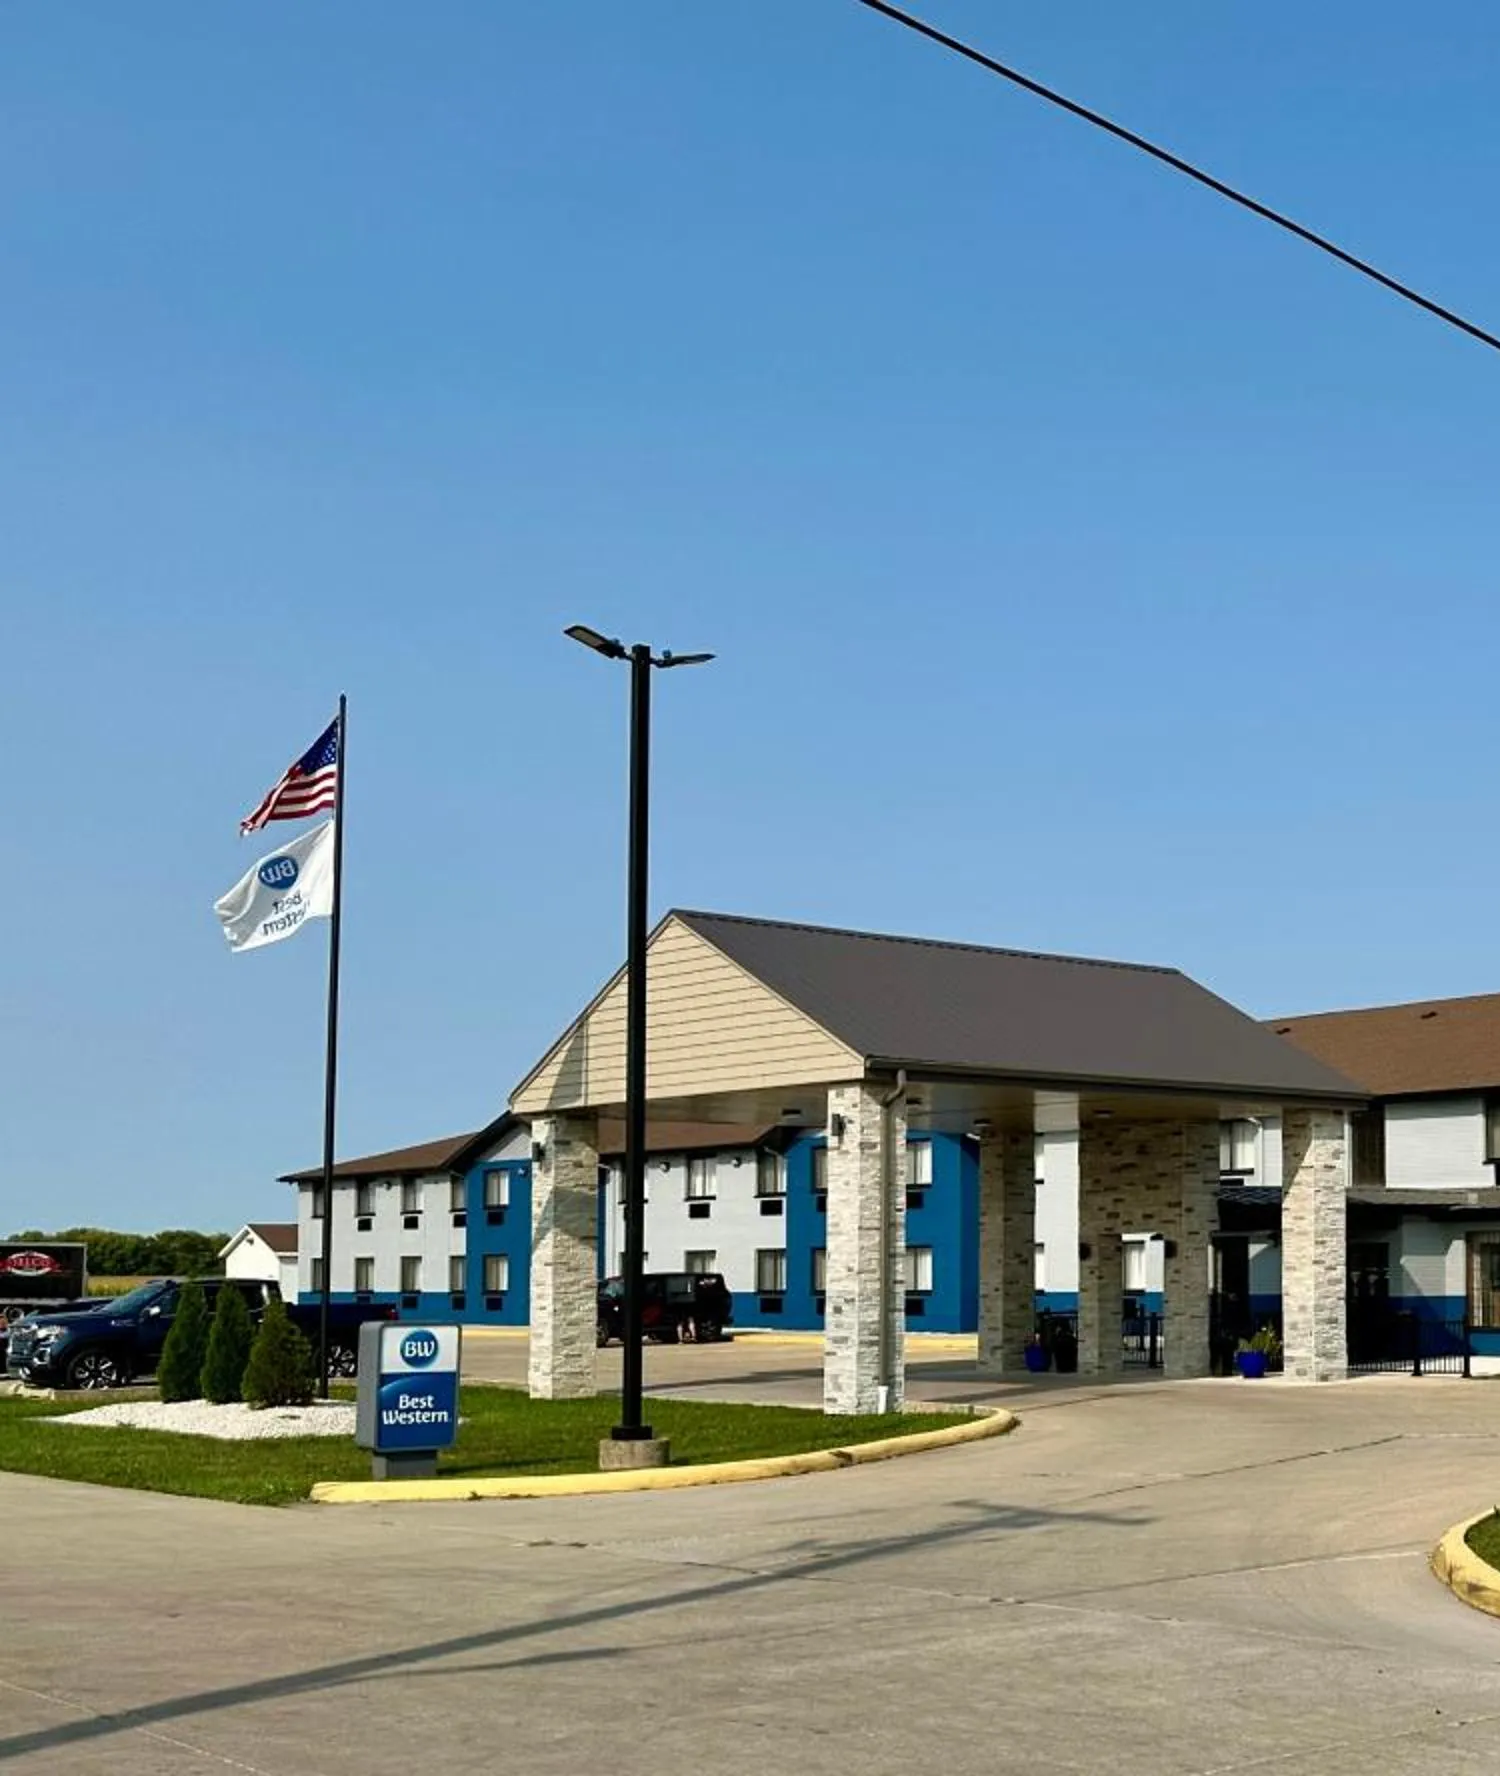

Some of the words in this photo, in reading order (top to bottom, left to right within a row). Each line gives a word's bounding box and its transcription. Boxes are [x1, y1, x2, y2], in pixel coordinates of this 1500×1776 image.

[404, 1340, 435, 1358] BW
[399, 1393, 435, 1409] Best
[382, 1410, 449, 1425] Western
